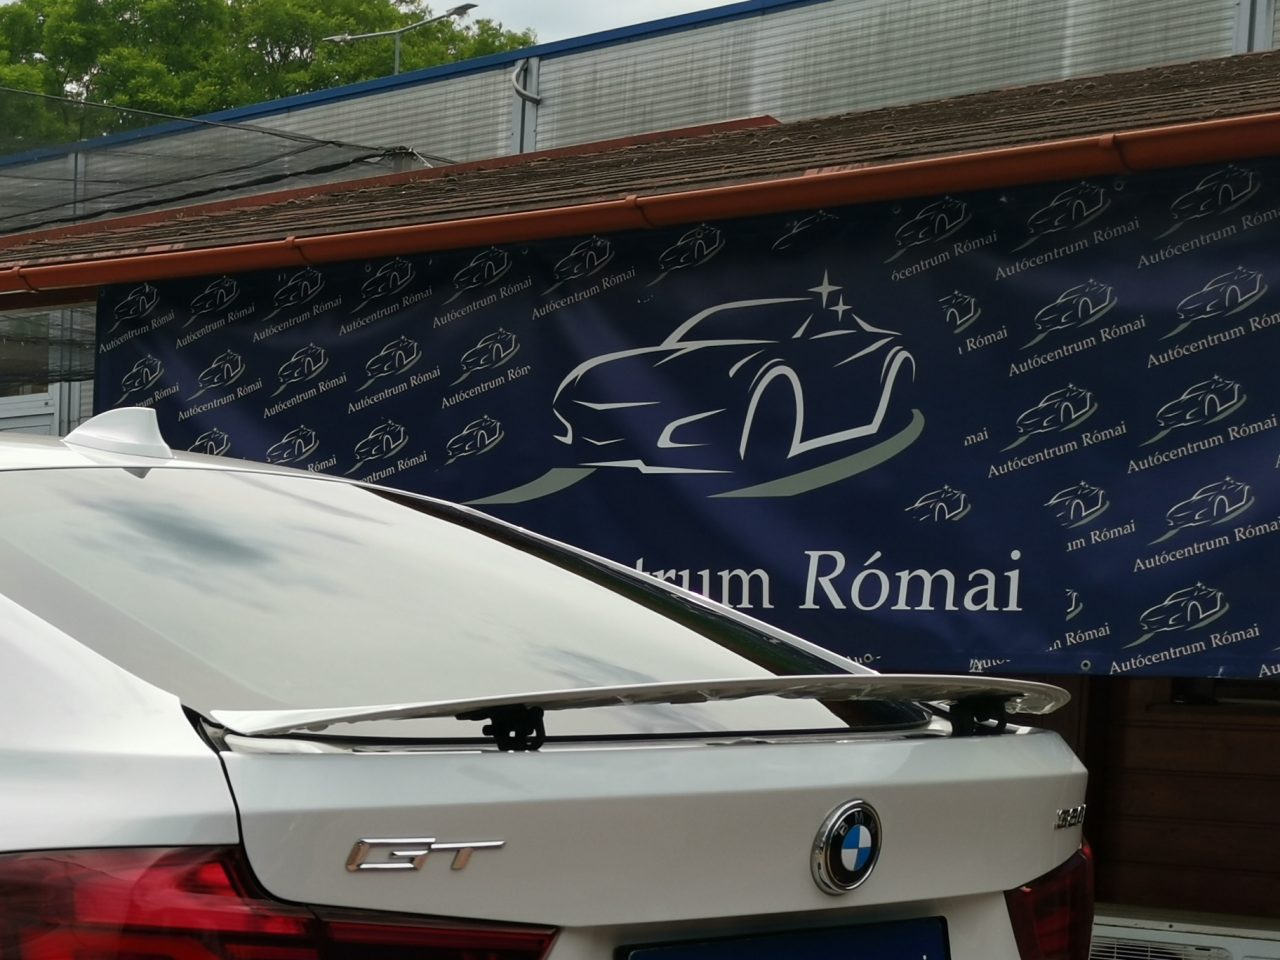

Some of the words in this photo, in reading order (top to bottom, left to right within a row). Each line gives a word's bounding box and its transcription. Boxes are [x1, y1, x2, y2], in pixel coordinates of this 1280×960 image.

[953, 230, 998, 257] Római
[994, 239, 1089, 281] Autócentrum
[1093, 215, 1140, 245] Római
[1137, 224, 1236, 269] Autócentrum
[338, 303, 400, 336] Autócentrum
[402, 286, 433, 308] Római
[432, 295, 497, 328] Autócentrum
[499, 275, 533, 300] Római
[531, 287, 599, 320] Autócentrum
[601, 265, 636, 291] Római
[99, 325, 149, 354] Autócentrum
[151, 310, 175, 330] Római
[175, 319, 225, 349] Autócentrum
[227, 303, 255, 322] Római
[252, 313, 311, 343] Autócentrum
[312, 295, 342, 316] Római
[966, 325, 1008, 351] Római
[1008, 336, 1096, 377] Autócentrum
[1100, 314, 1146, 343] Római
[1148, 325, 1245, 369] Autócentrum
[154, 382, 180, 401] Római
[178, 392, 235, 422] Autócentrum
[237, 378, 263, 397] Római
[263, 388, 317, 419] Autócentrum
[318, 372, 348, 392] Római
[347, 381, 408, 414] Autócentrum
[409, 365, 441, 387] Római
[441, 375, 505, 409] Autócentrum
[397, 450, 428, 472] Római
[988, 441, 1078, 479] Autócentrum
[1081, 420, 1127, 447] Római
[1127, 434, 1224, 474] Autócentrum
[1227, 413, 1278, 441] Római
[1090, 519, 1136, 545] Római
[1133, 535, 1230, 573] Autócentrum
[798, 549, 1023, 612] Római
[1065, 622, 1111, 647] Római
[1109, 640, 1206, 675] Autócentrum
[1210, 623, 1260, 649] Római
[346, 837, 506, 872] GT
